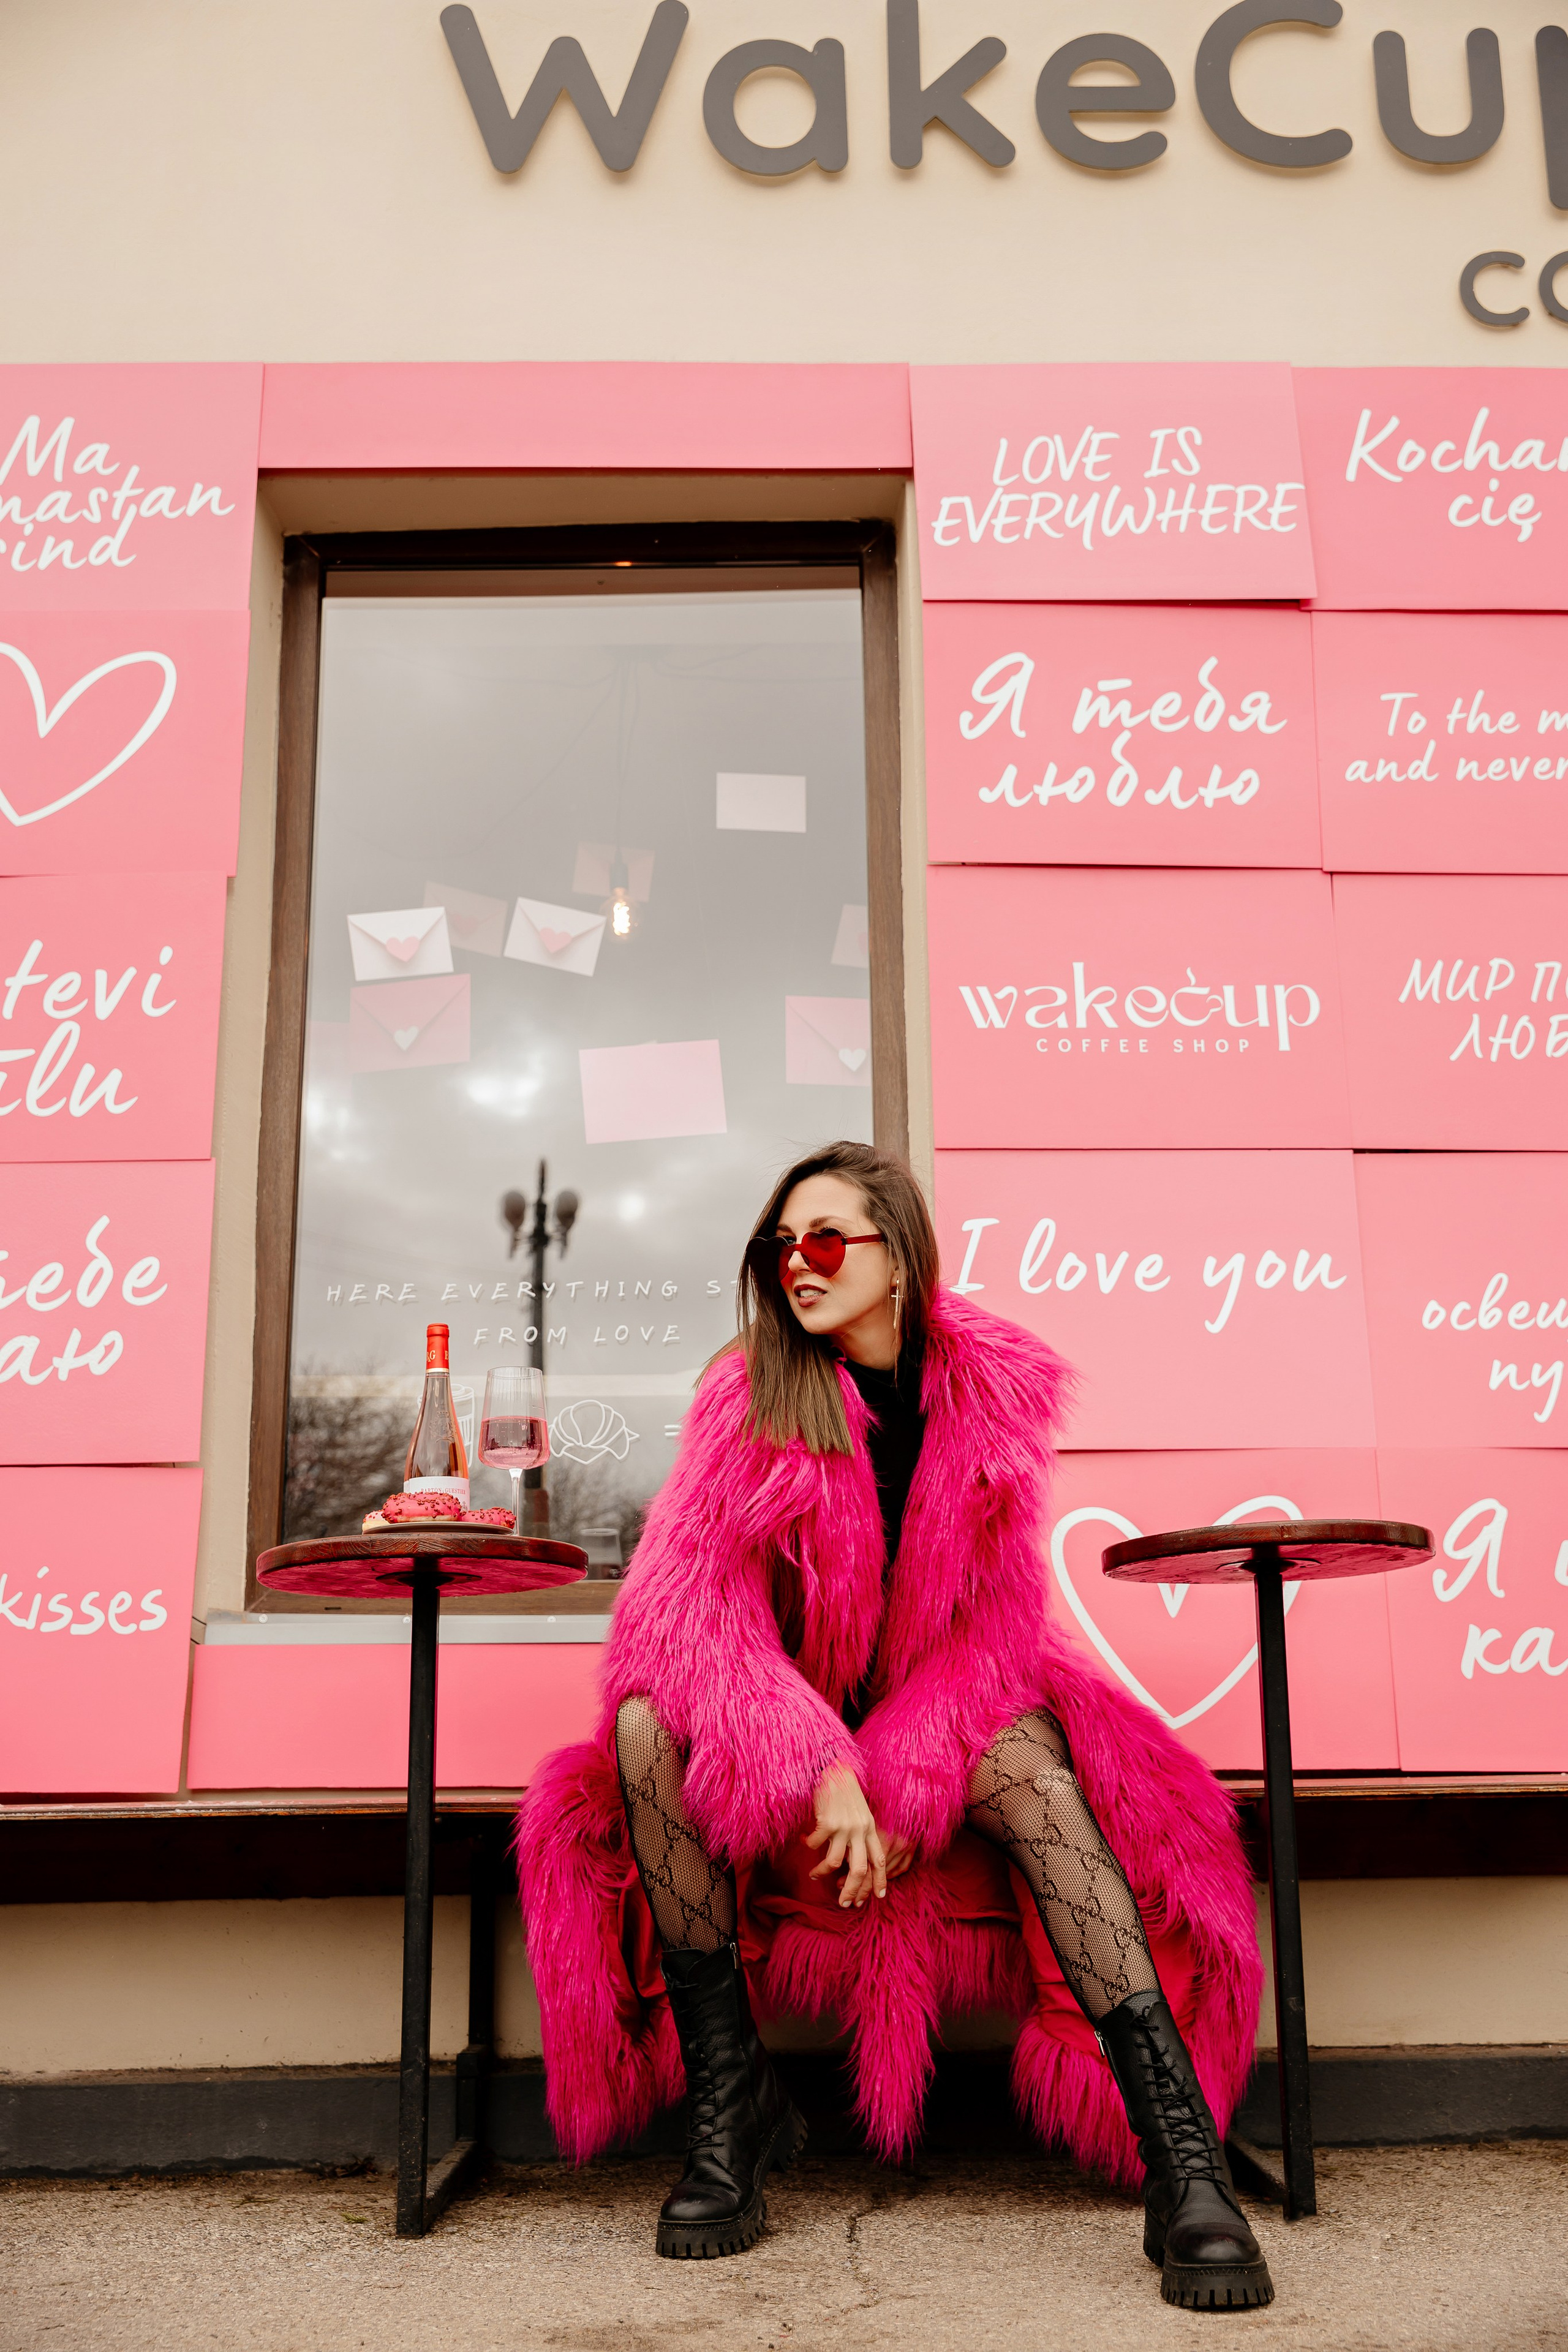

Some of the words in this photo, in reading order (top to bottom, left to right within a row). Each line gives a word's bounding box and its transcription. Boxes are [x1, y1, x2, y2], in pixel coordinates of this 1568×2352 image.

[440, 0, 1568, 210] WakeCu
[0, 415, 120, 484] Ma
[992, 425, 1120, 486] LOVE
[1143, 426, 1202, 478] IS
[0, 503, 137, 572] ind
[931, 482, 1305, 551] EVERYWHERE
[1448, 478, 1542, 543] cię
[959, 652, 1035, 740] Я
[1072, 657, 1287, 734] тебя
[1380, 692, 1427, 736] To
[1446, 689, 1520, 734] the
[978, 729, 1260, 809] люблю
[1345, 739, 1439, 783] and
[2, 939, 177, 1020] tevi
[959, 962, 1321, 1052] wakecup
[1398, 957, 1515, 1004] МИР
[1036, 1038, 1149, 1054] COFFEE
[1173, 1038, 1250, 1054] SHOP
[327, 1283, 417, 1302] HERE
[441, 1280, 678, 1301] EVERYTHING
[949, 1218, 1000, 1295] I
[1019, 1218, 1171, 1294] love
[1202, 1248, 1347, 1334] you
[473, 1325, 567, 1346] FROM
[594, 1325, 680, 1343] LOVE
[1432, 1498, 1509, 1602] Я
[0, 1566, 168, 1635] kisses
